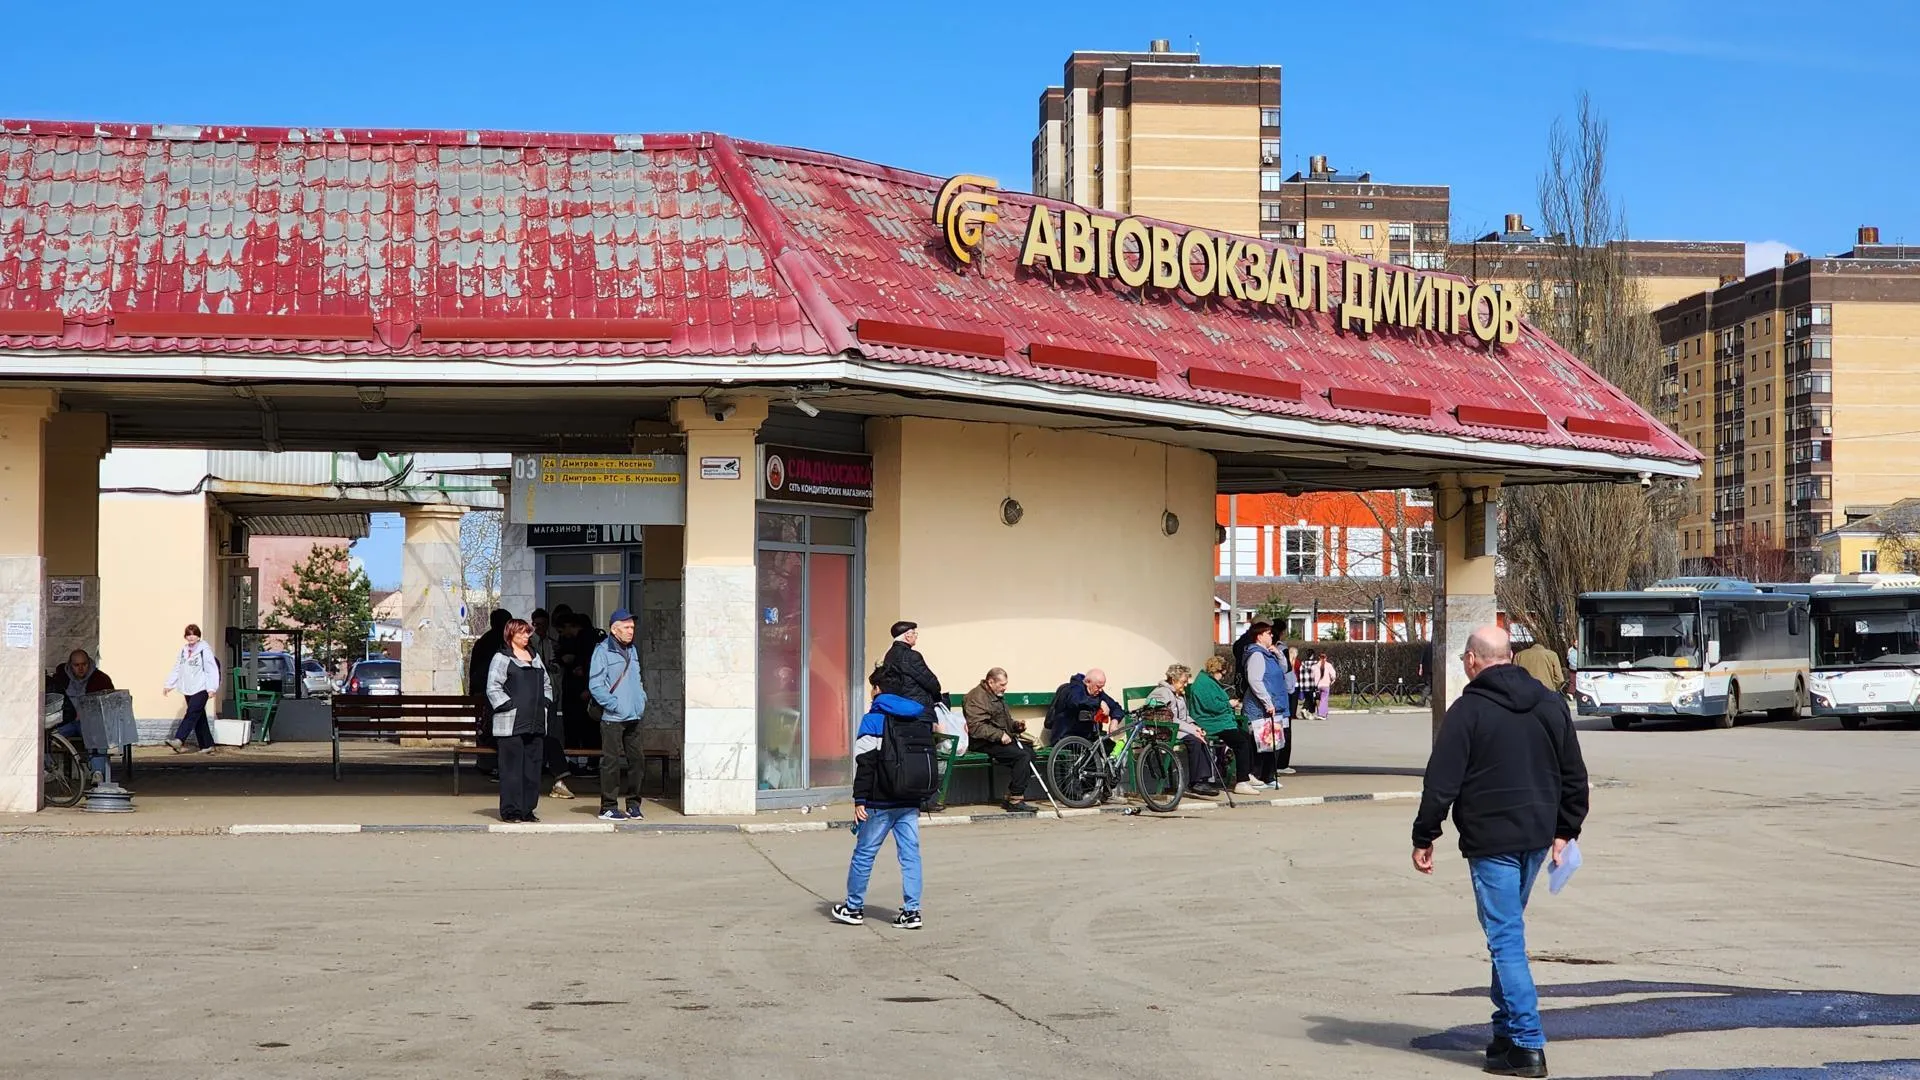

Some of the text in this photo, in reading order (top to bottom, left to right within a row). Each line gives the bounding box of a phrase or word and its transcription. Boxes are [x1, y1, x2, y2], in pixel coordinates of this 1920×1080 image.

[1021, 204, 1520, 345] АВТОВОКЗАЛ ДМИТРОВ
[515, 458, 537, 479] 03
[544, 460, 555, 468] 24
[561, 459, 598, 468] Дмитров
[618, 460, 653, 468] Костино
[788, 458, 872, 484] СЛАДКОЕЖКА
[544, 474, 555, 482] 29
[561, 474, 597, 482] Дмитров
[603, 474, 619, 482] РТС
[635, 474, 677, 483] Кузнецово
[788, 482, 873, 498] СЕТЬ КОНДИТЕРСКИХ МАГАЗИНОВ
[533, 525, 582, 534] МАГАЗИНОВ
